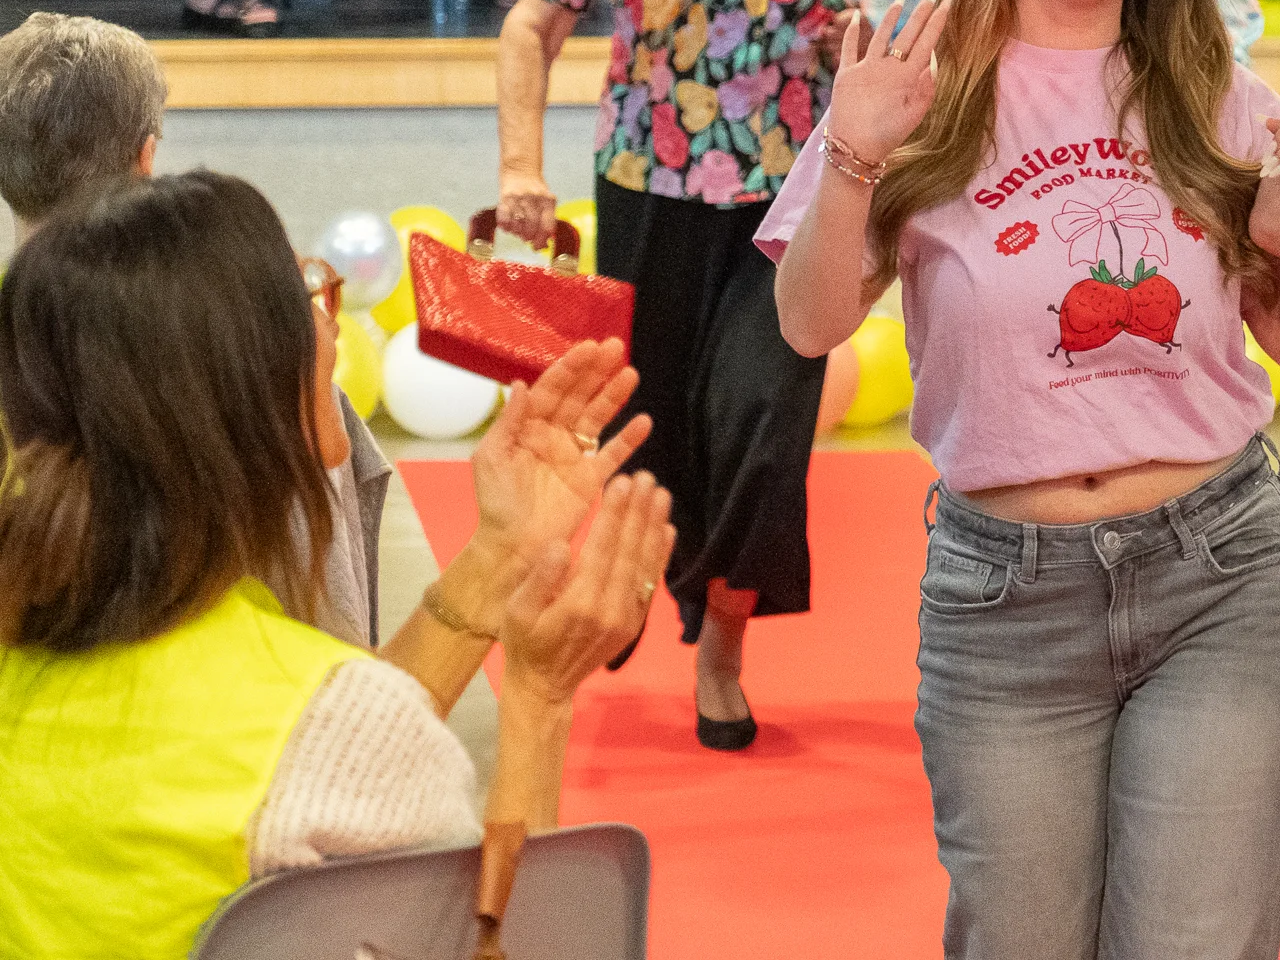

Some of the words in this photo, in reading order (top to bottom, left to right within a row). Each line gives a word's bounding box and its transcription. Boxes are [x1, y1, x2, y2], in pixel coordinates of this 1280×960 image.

[974, 138, 1155, 210] SmileyWo
[1030, 173, 1075, 200] FOOD
[1079, 168, 1153, 185] MARKET
[1002, 226, 1027, 245] FRESH
[1049, 378, 1070, 390] Feed
[1071, 374, 1092, 386] your
[1095, 369, 1118, 379] mind
[1121, 367, 1141, 376] with
